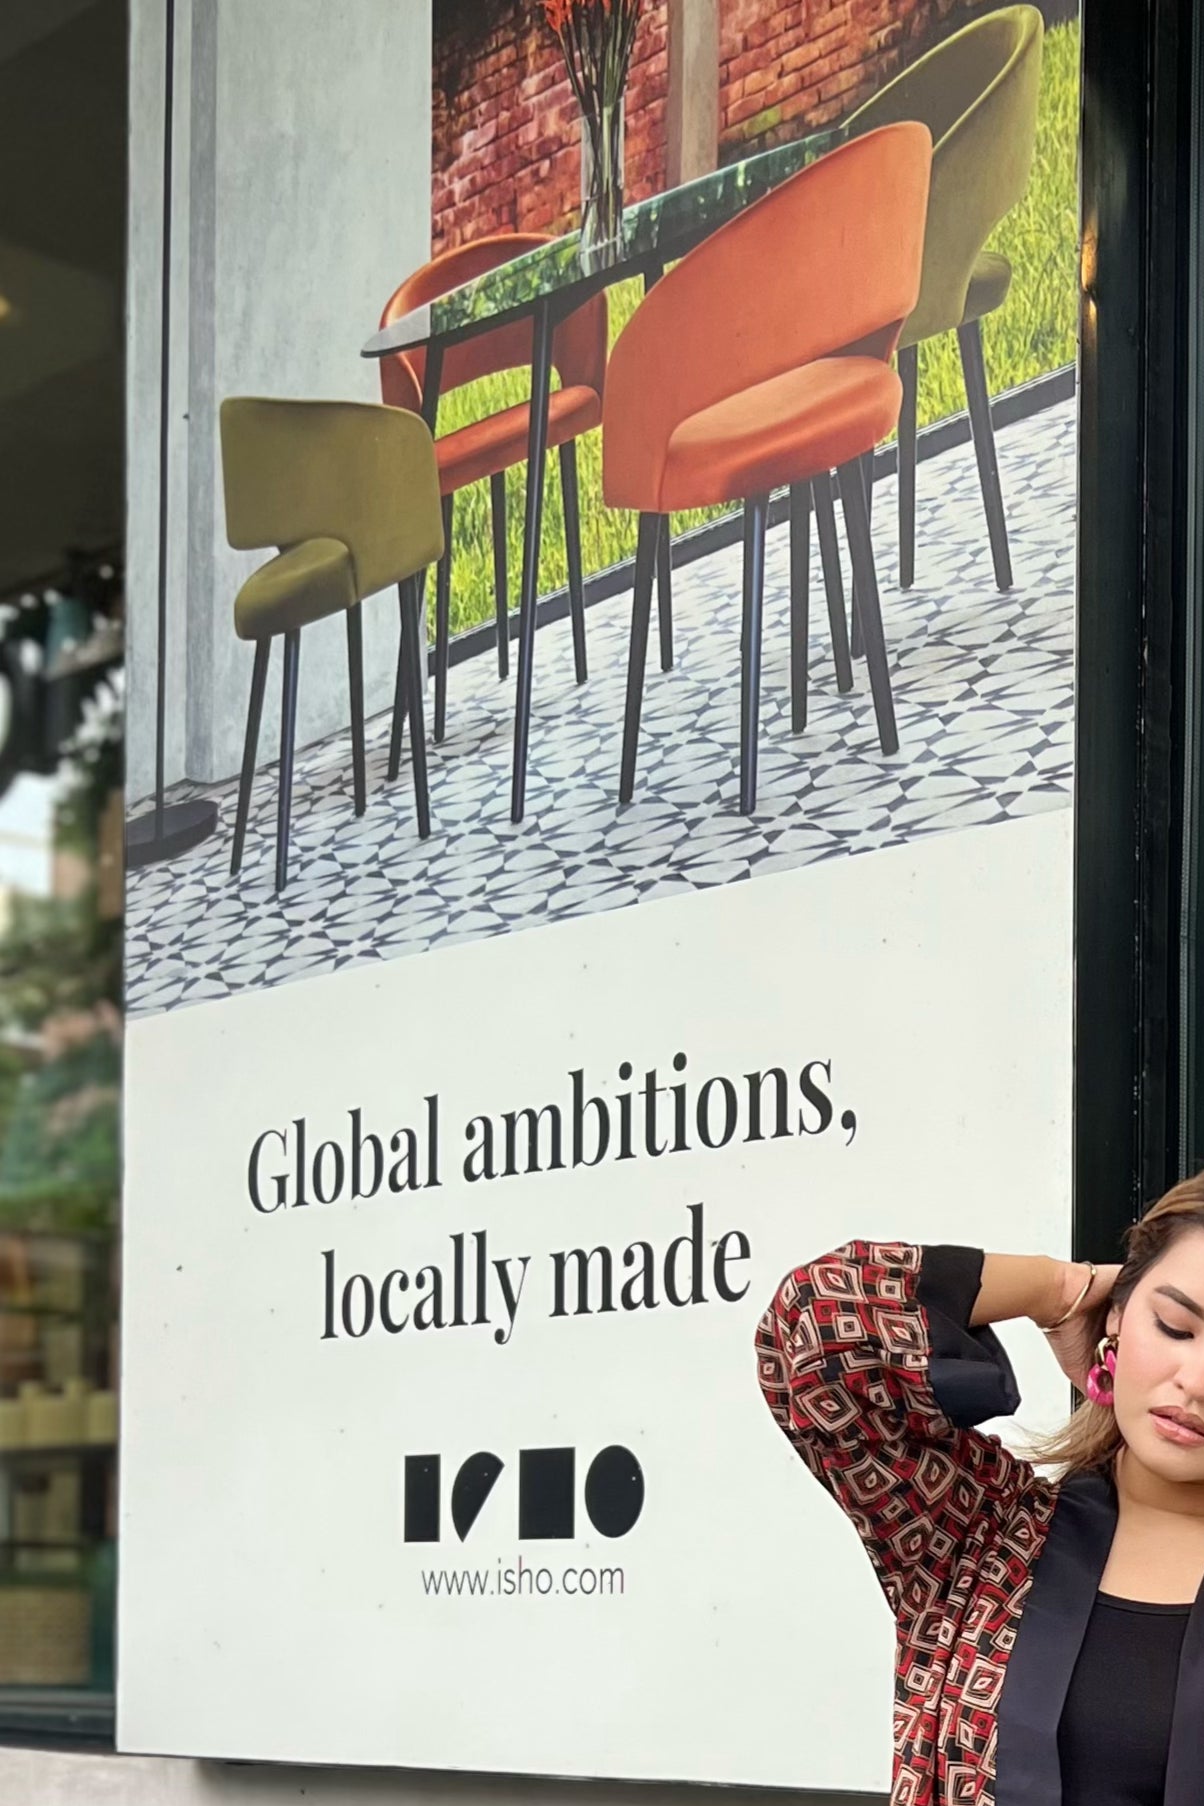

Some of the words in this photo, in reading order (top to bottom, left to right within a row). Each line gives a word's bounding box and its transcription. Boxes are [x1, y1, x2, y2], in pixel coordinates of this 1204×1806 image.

[246, 1094, 443, 1214] Global
[463, 1052, 858, 1184] ambitions,
[320, 1229, 532, 1346] locally
[548, 1202, 752, 1318] made
[421, 1556, 625, 1596] www.isho.com
